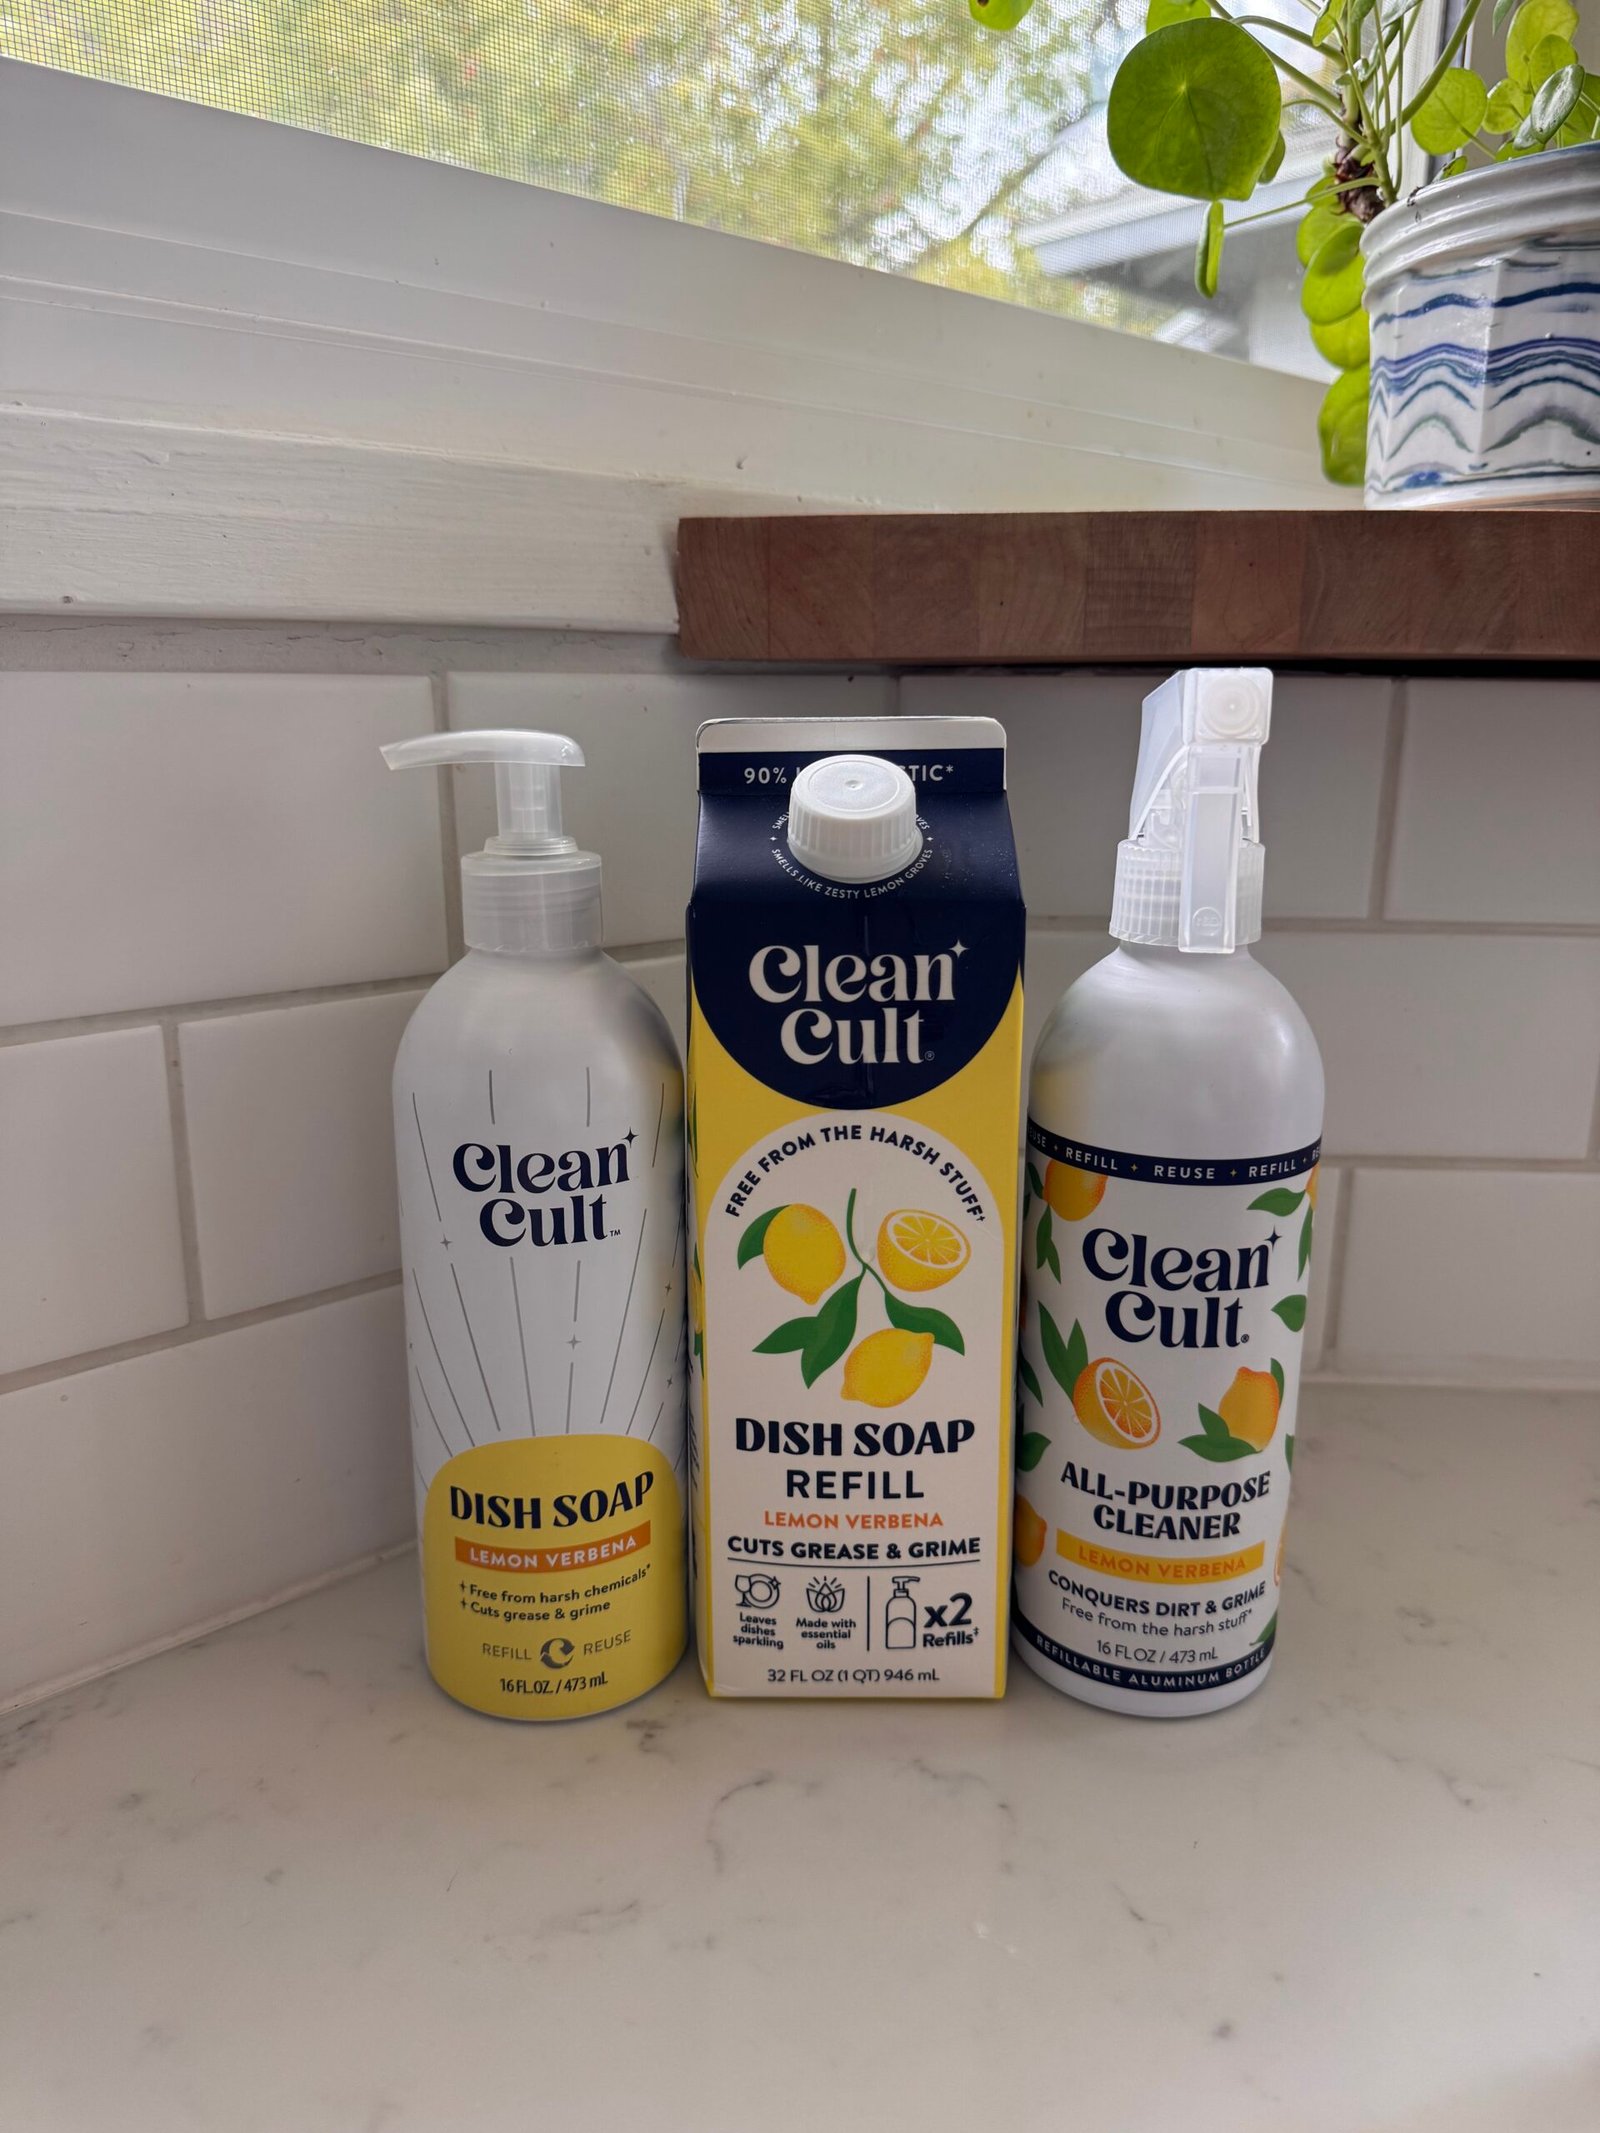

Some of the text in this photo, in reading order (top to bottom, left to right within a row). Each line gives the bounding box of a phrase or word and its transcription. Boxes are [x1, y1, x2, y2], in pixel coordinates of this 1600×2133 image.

[744, 766, 787, 784] 90%
[771, 848, 933, 899] SMELLS LIKE ZESTY LEMON GROVES
[749, 944, 956, 1003] Clean
[453, 1142, 630, 1194] Clean
[725, 1170, 761, 1217] FREE
[758, 1132, 816, 1173] FROM
[820, 1124, 862, 1143] THE
[869, 1126, 940, 1165] HARSH
[1065, 1147, 1118, 1170] REFILL
[1154, 1165, 1216, 1180] REUSE
[1248, 1159, 1297, 1178] REFILL
[1082, 1228, 1270, 1292] Clean
[735, 1417, 843, 1456] DISH
[853, 1419, 975, 1456] SOAP
[450, 1470, 654, 1529] DISH SOAP
[786, 1469, 925, 1500] REFILL
[1060, 1461, 1271, 1511] ALL-PURPOSE
[764, 1510, 944, 1530] LEMON VERBENA
[1093, 1504, 1241, 1540] CLEANER
[470, 1535, 637, 1568] LEMON VERBENA
[727, 1535, 981, 1560] CUTS GREASE & GRIME
[1078, 1545, 1247, 1579] LEMON VERBENA
[470, 1584, 498, 1600] Free
[501, 1590, 536, 1603] from
[540, 1590, 580, 1603] harsh
[1048, 1569, 1266, 1617] CONQUERS DIRT & GRIME
[471, 1601, 611, 1622] Cuts grease & grime
[739, 1612, 777, 1626] Leaves
[795, 1618, 856, 1629] Made with
[924, 1592, 972, 1628] x2
[1062, 1597, 1094, 1621] Free
[1097, 1612, 1137, 1633] from
[1142, 1620, 1169, 1636] the
[1173, 1621, 1214, 1638] harsh
[482, 1630, 632, 1660] REFILL REUSE
[732, 1634, 784, 1650] sparkling
[740, 1624, 775, 1637] dishes
[801, 1629, 851, 1640] essential
[816, 1639, 836, 1650] oils
[1036, 1635, 1265, 1687] REFILLABLE ALUMINUM BOTTLE
[1097, 1639, 1111, 1655] 16
[1159, 1650, 1166, 1663] /
[1169, 1650, 1195, 1664] 473
[1199, 1647, 1218, 1662] mL
[500, 1678, 515, 1692] 16
[556, 1679, 563, 1695] /
[564, 1677, 587, 1692] 473
[590, 1671, 609, 1688] mL
[767, 1668, 940, 1685] 32 FL OZ (1 QT) 946 mL
